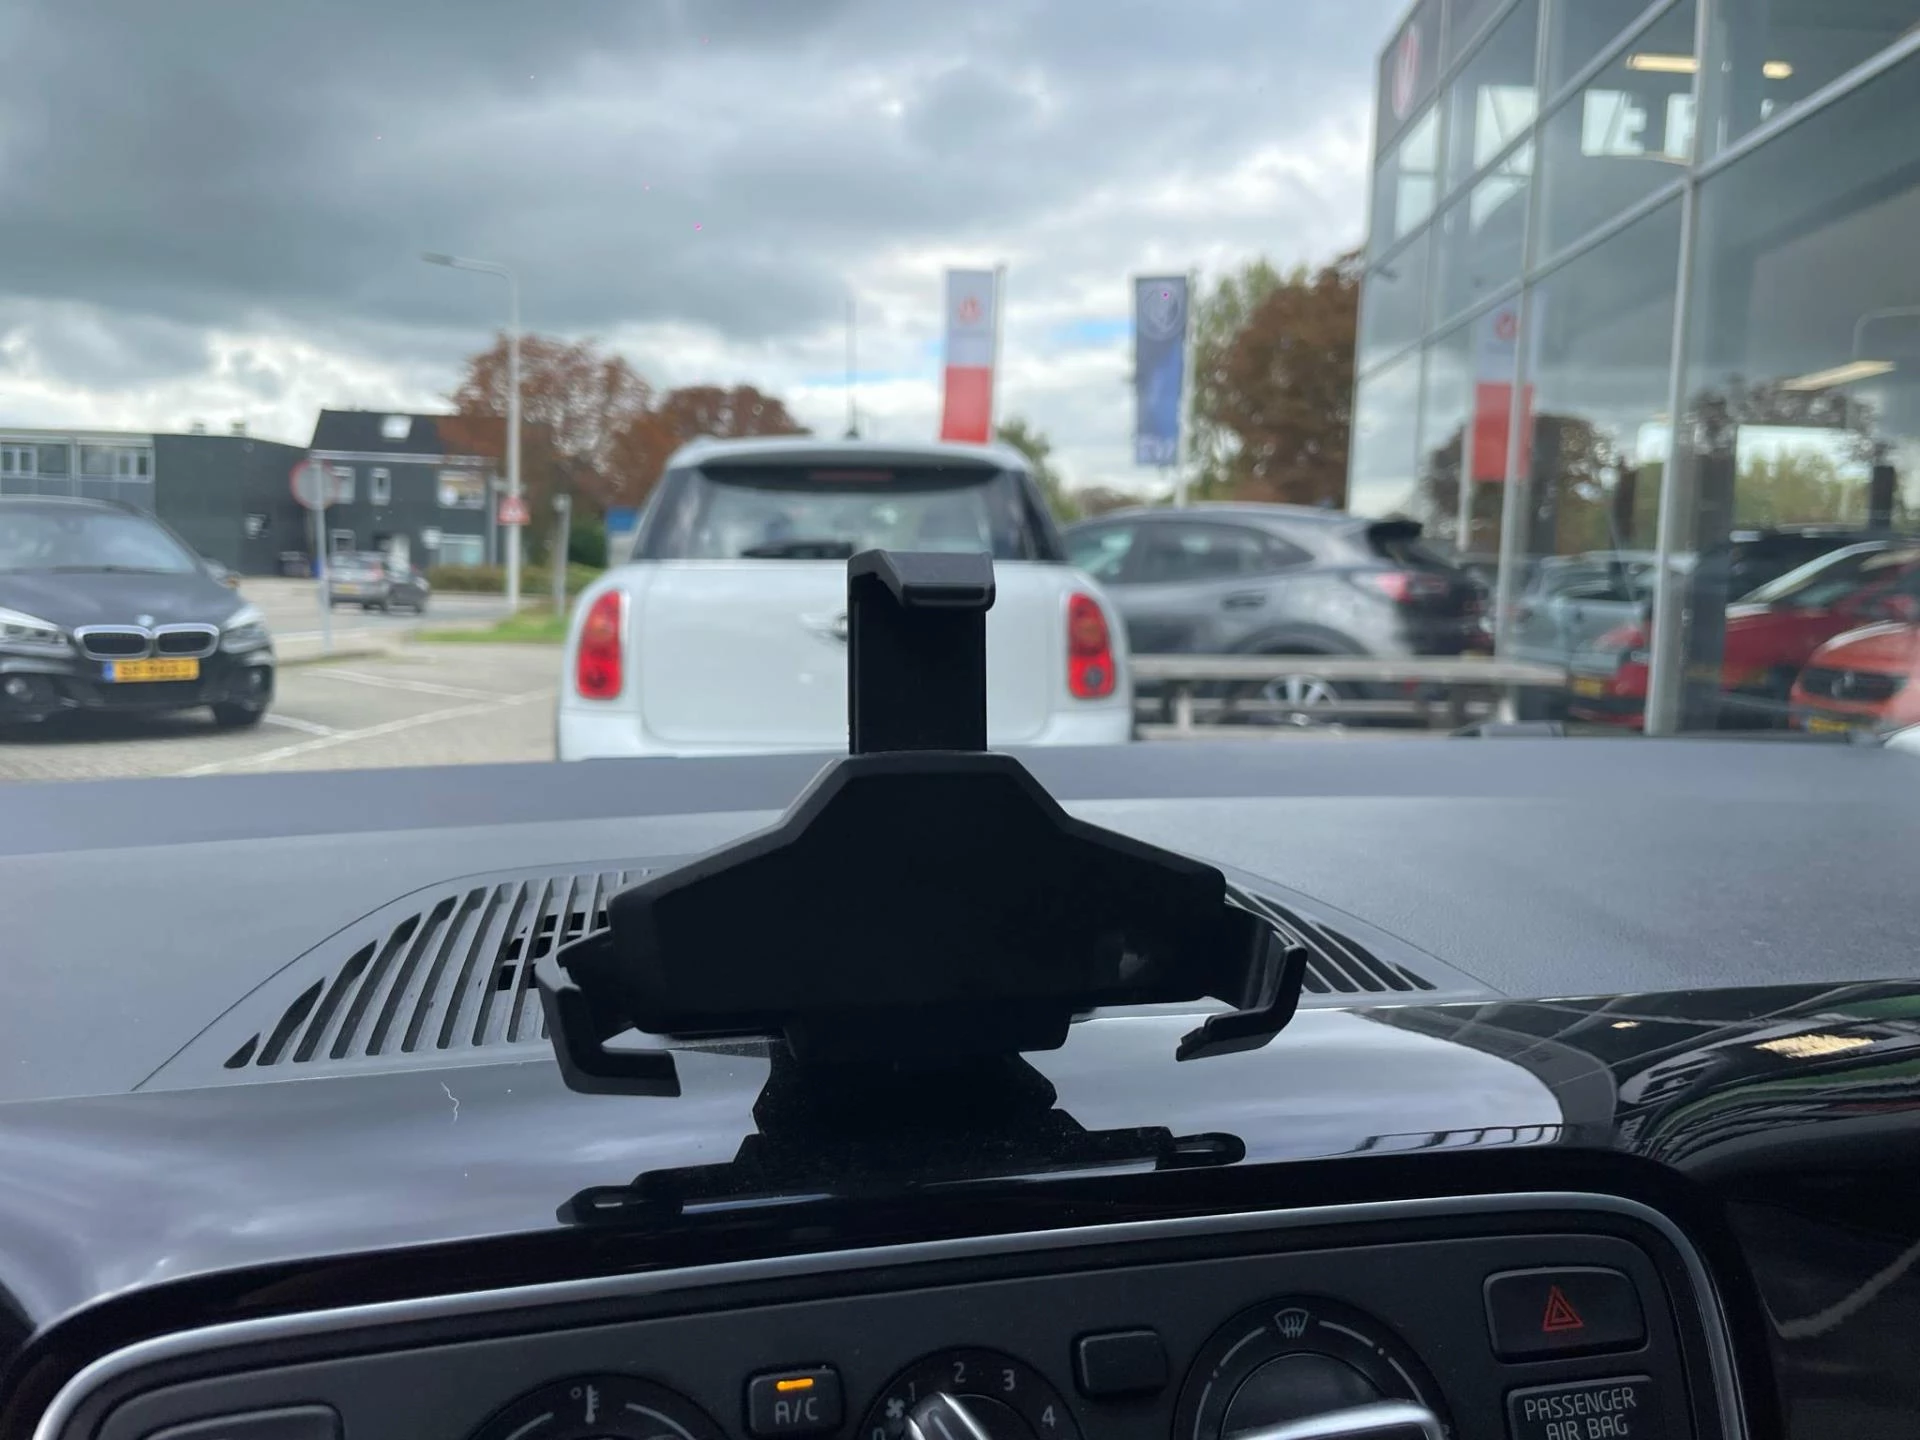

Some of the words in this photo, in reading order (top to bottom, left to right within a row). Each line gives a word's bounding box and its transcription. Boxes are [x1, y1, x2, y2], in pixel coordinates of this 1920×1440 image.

[952, 1361, 967, 1383] 2
[1002, 1369, 1016, 1391] 3
[908, 1381, 916, 1402] 1
[775, 1396, 819, 1425] A/C
[1041, 1404, 1057, 1427] 4
[1523, 1386, 1637, 1422] PASSENGER
[1545, 1420, 1582, 1440] AIR
[1586, 1413, 1629, 1440] BAG
